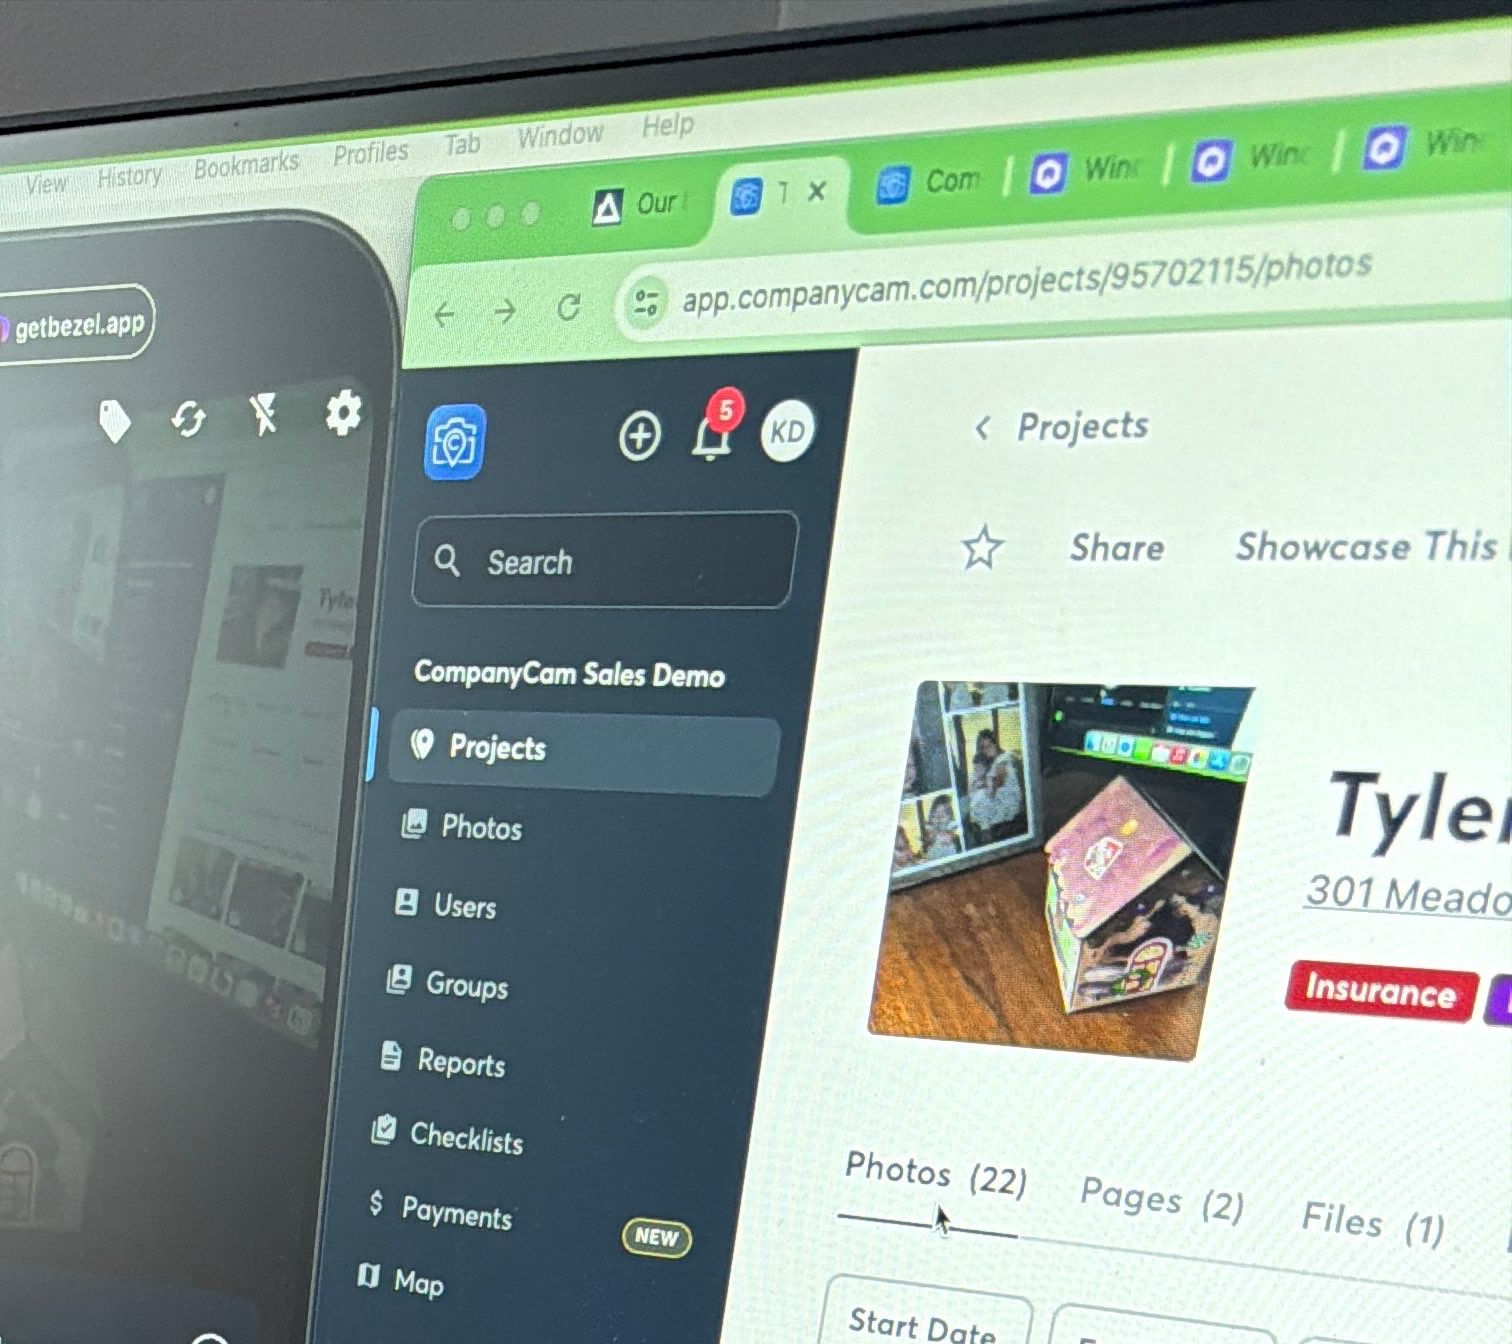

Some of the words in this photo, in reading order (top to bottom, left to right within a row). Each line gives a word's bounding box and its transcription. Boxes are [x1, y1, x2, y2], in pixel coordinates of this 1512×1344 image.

[518, 121, 604, 148] Window
[643, 113, 694, 138] Help
[333, 139, 409, 166] Profiles
[445, 133, 481, 156] Tab
[98, 164, 163, 190] History
[195, 151, 300, 179] Bookmarks
[26, 173, 69, 195] View
[637, 191, 676, 215] Our
[683, 248, 1373, 315] app.companycam.com/projects/95702115/photos
[15, 311, 145, 343] getbezel.app
[719, 398, 734, 420] 5
[769, 418, 807, 445] KD
[1018, 410, 1149, 445] Projects
[1070, 532, 1165, 562] Share
[1236, 530, 1412, 562] Showcase
[1425, 528, 1498, 561] This
[488, 548, 573, 577] Search
[414, 659, 577, 690] CompanyCam
[583, 662, 646, 687] Sales
[652, 663, 726, 689] Demo
[450, 732, 547, 765] Projects
[442, 813, 523, 842] Photos
[435, 893, 497, 920] Users
[1307, 874, 1373, 908] 301
[426, 971, 509, 1003] Groups
[1306, 969, 1459, 1010] Insurance
[418, 1047, 506, 1079] Reports
[411, 1121, 524, 1156] Checklists
[846, 1149, 952, 1189] Photos
[969, 1162, 1028, 1201] (22)
[402, 1195, 513, 1231] Payments
[1081, 1175, 1182, 1217] Pages
[1202, 1188, 1245, 1227] (2)
[634, 1226, 680, 1248] NEW
[1301, 1201, 1383, 1239] Files
[1405, 1212, 1445, 1251] (1)
[394, 1268, 444, 1301] Map
[849, 1307, 919, 1340] Start
